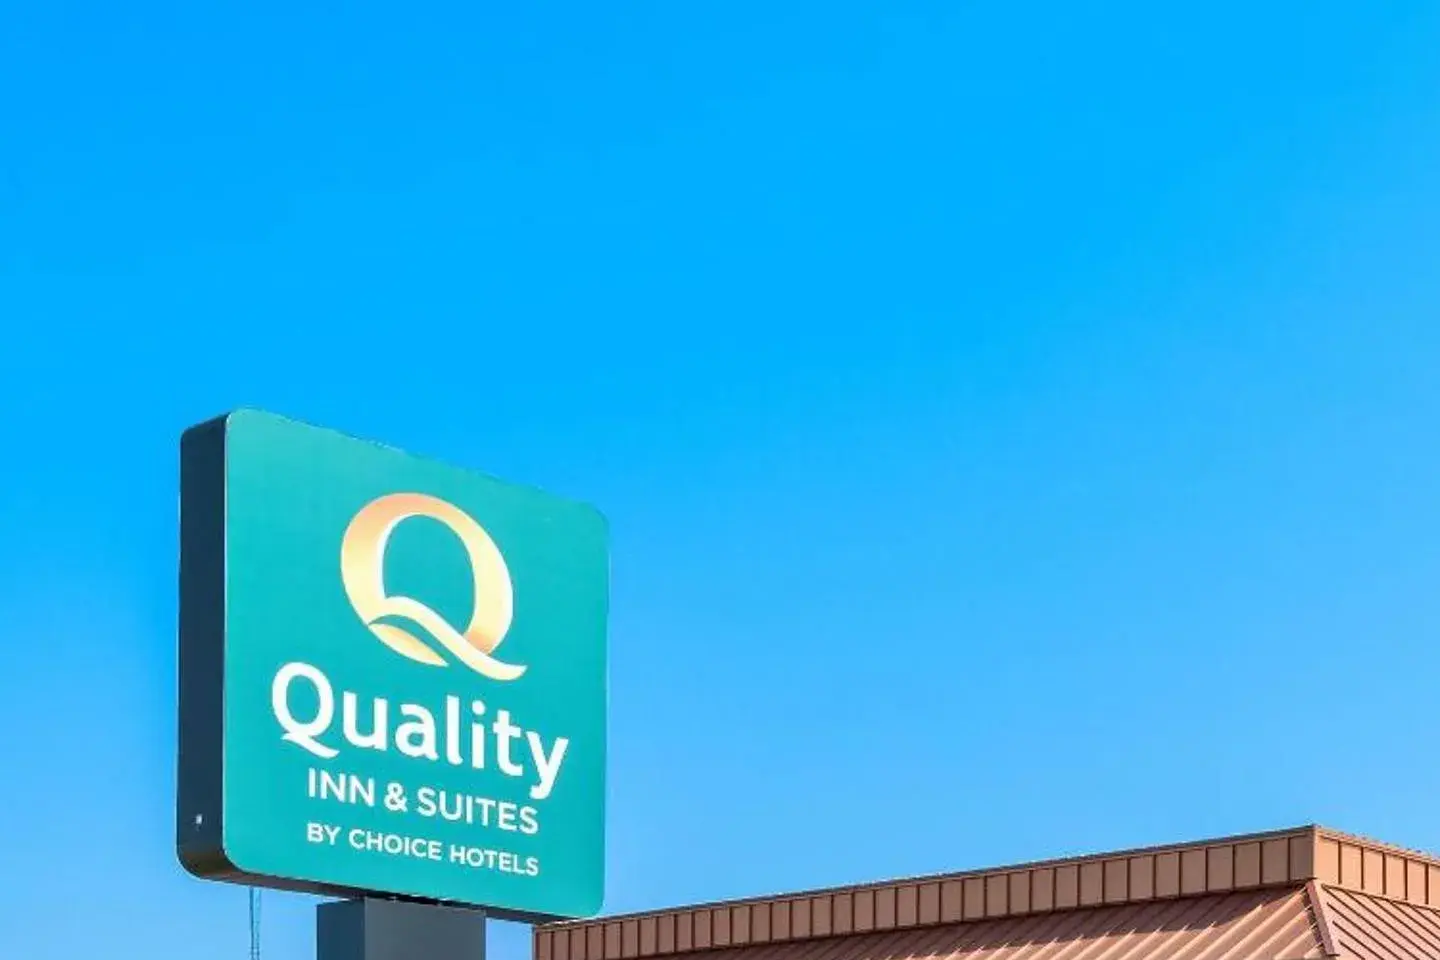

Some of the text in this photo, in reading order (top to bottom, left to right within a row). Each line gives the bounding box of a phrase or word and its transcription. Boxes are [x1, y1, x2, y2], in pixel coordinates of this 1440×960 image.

[340, 492, 527, 681] Q
[271, 661, 569, 800] Quality
[307, 822, 539, 876] BY CHOICE HOTELS
[308, 768, 539, 835] INN & SUITES
